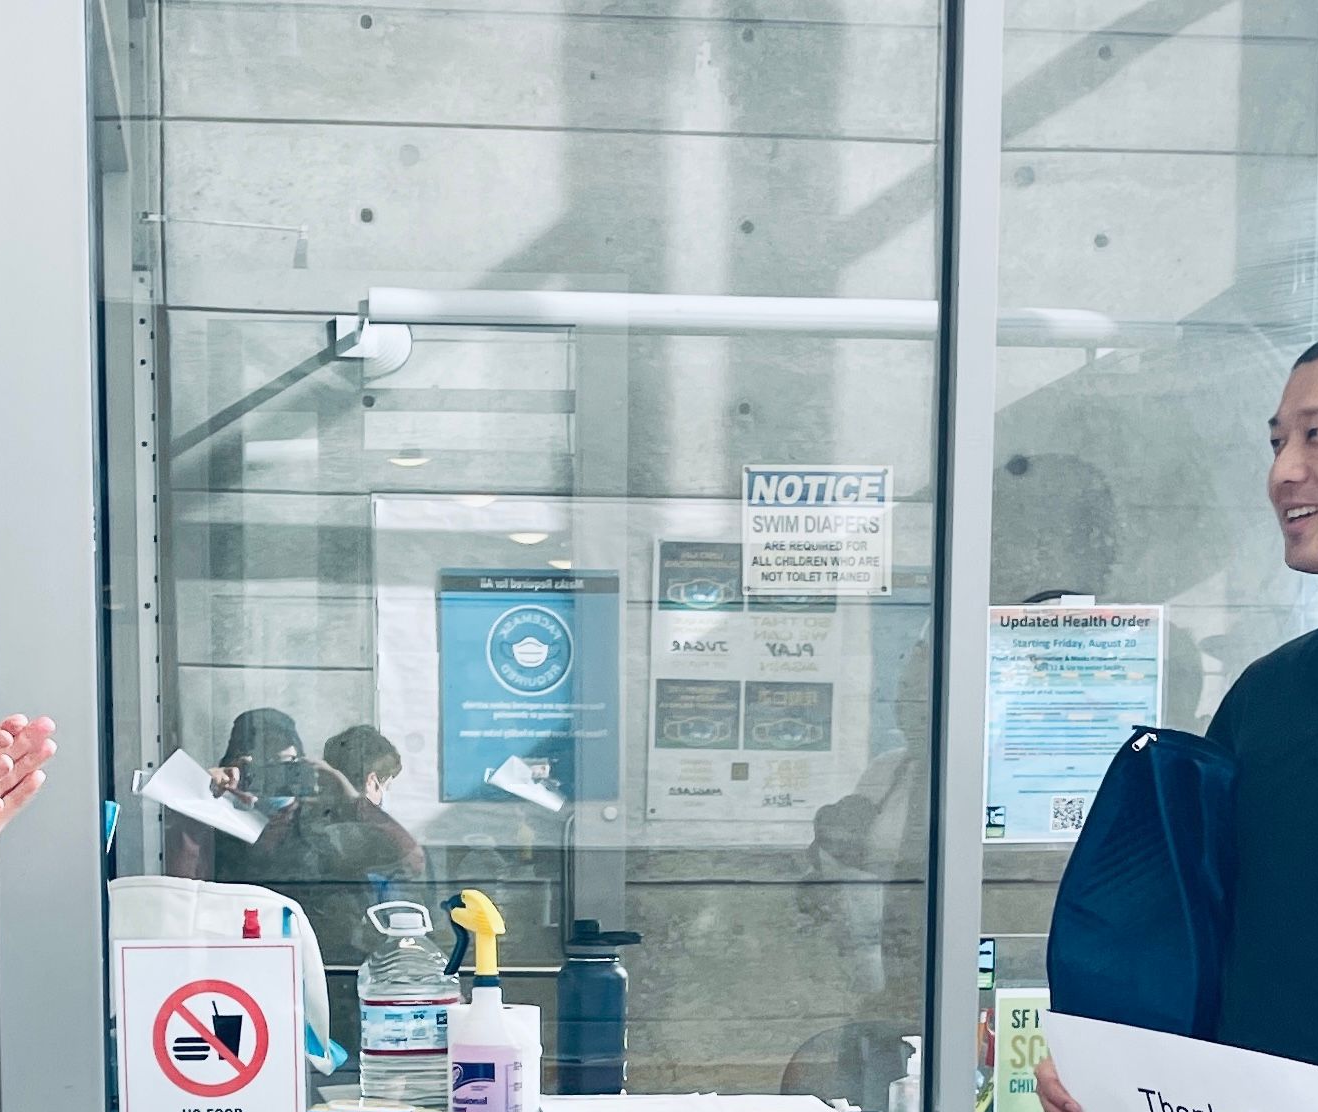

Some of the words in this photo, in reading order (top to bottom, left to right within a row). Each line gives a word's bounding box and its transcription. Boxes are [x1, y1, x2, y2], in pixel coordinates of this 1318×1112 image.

[751, 475, 882, 505] NOTICE
[752, 515, 799, 533] SWIM
[804, 516, 880, 533] DIAPERS
[764, 541, 786, 551] ARE
[789, 541, 843, 551] REQUIRED
[846, 541, 868, 551] FOR
[751, 556, 772, 567] ALL
[774, 556, 828, 567] CHILDREN
[830, 556, 856, 567] WHO
[858, 556, 880, 567] ARE
[761, 572, 782, 582] NOT
[787, 572, 822, 582] TOILET
[826, 572, 870, 582] TRAINED
[1000, 615, 1059, 630] Updated
[1063, 615, 1107, 628] Health
[1110, 615, 1151, 627] Order
[1012, 638, 1050, 649] Starting
[1053, 638, 1086, 649] Friday,
[1088, 639, 1122, 649] August
[1123, 639, 1137, 648] 20
[1011, 1009, 1030, 1029] SF
